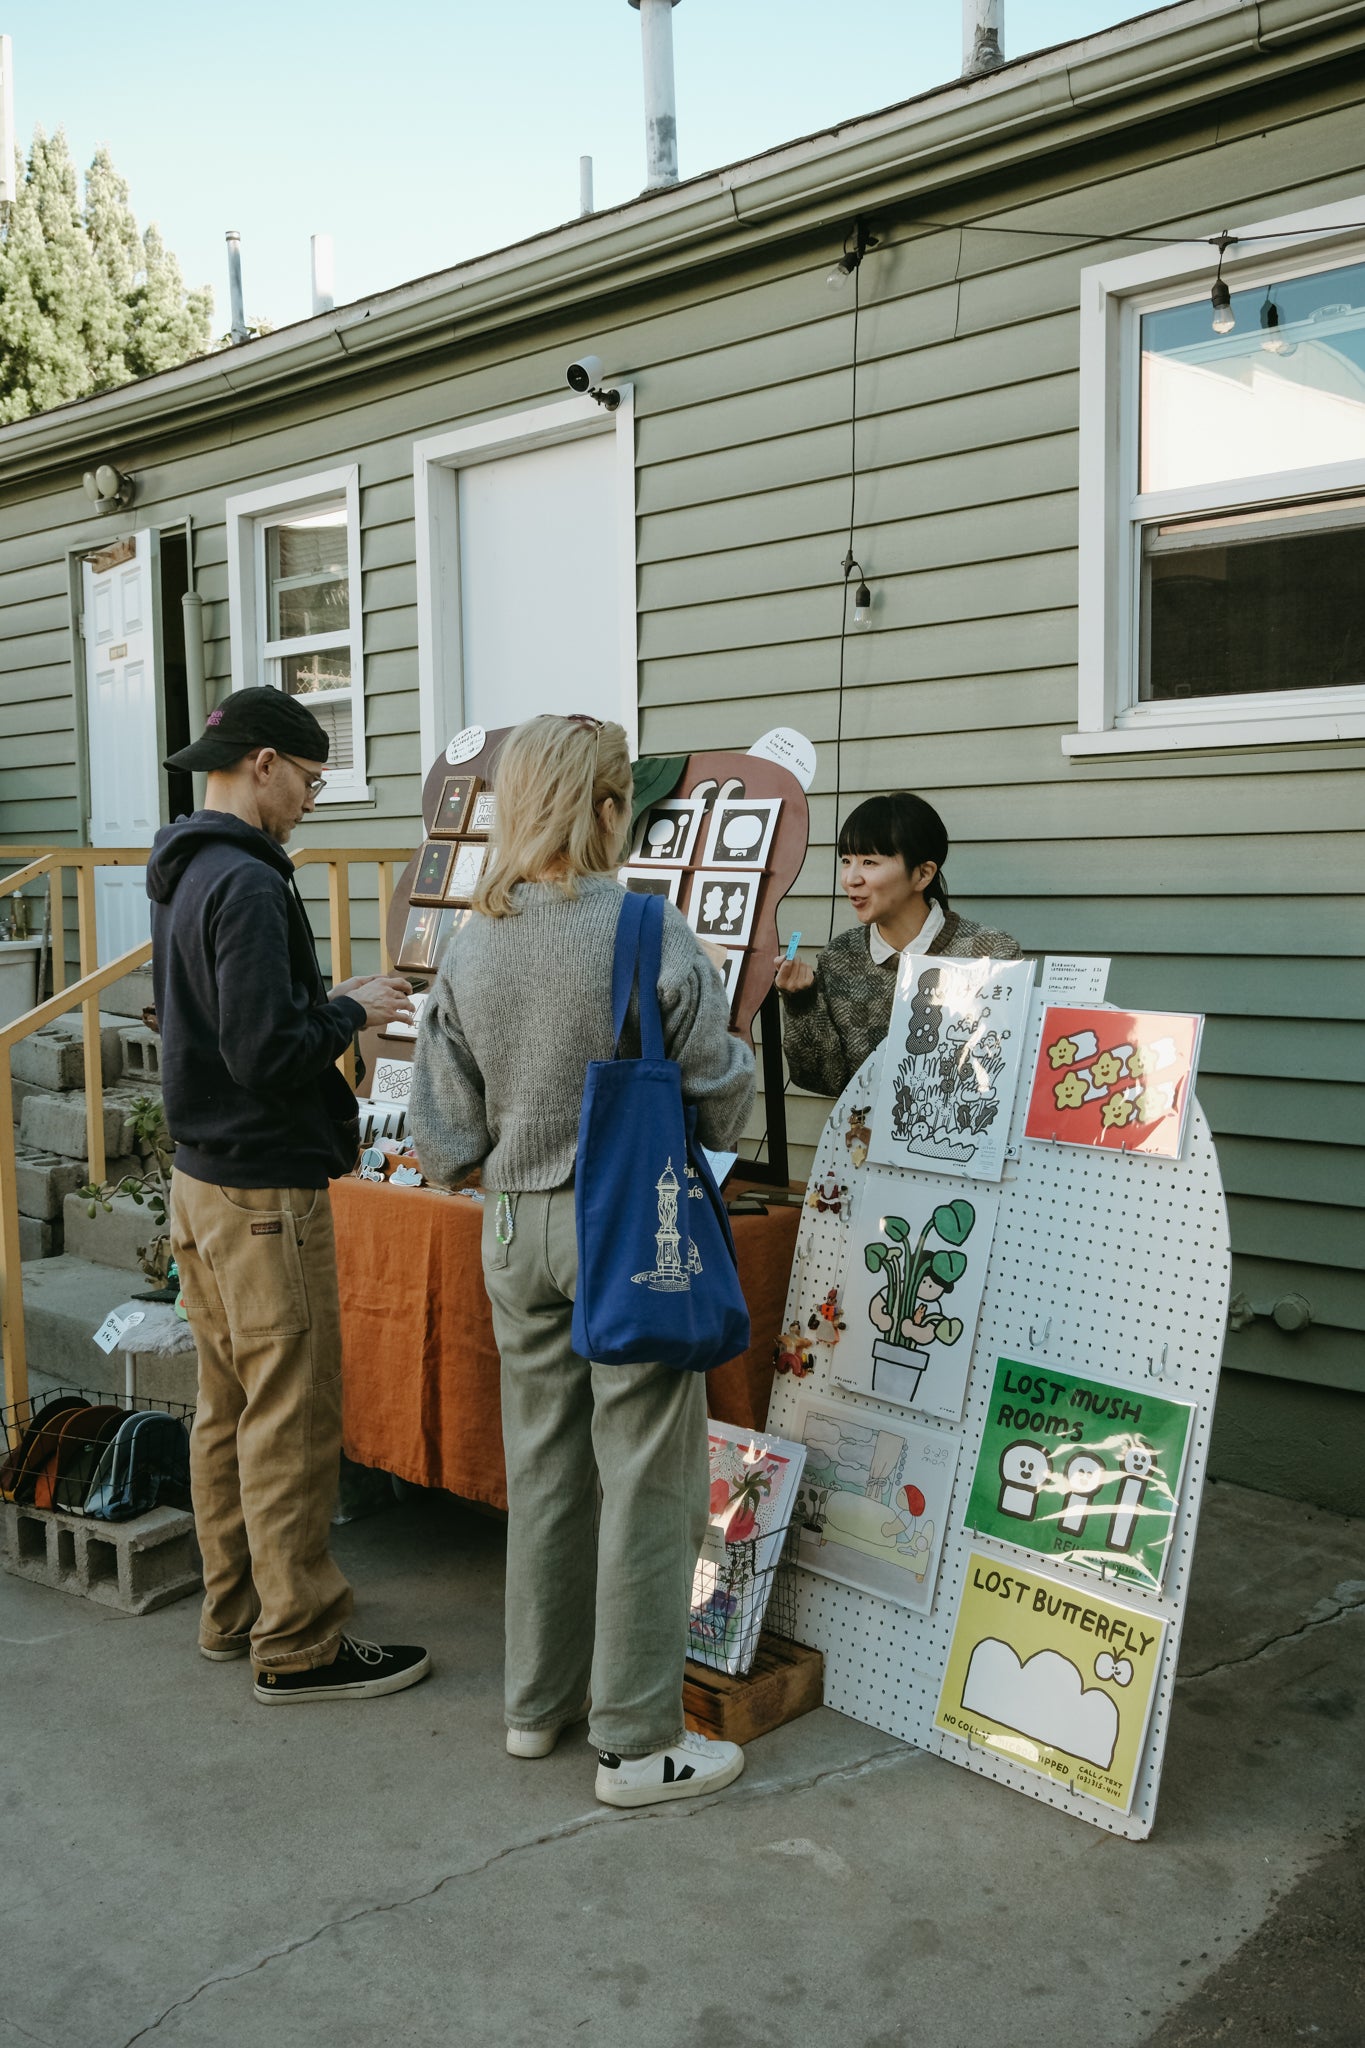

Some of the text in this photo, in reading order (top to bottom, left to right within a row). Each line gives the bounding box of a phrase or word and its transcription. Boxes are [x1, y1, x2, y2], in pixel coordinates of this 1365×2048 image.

[1003, 1369, 1066, 1405] LOST
[996, 1403, 1084, 1442] ROOMS
[973, 1568, 1155, 1657] LOST BUTTERFLY
[943, 1713, 956, 1725] NO
